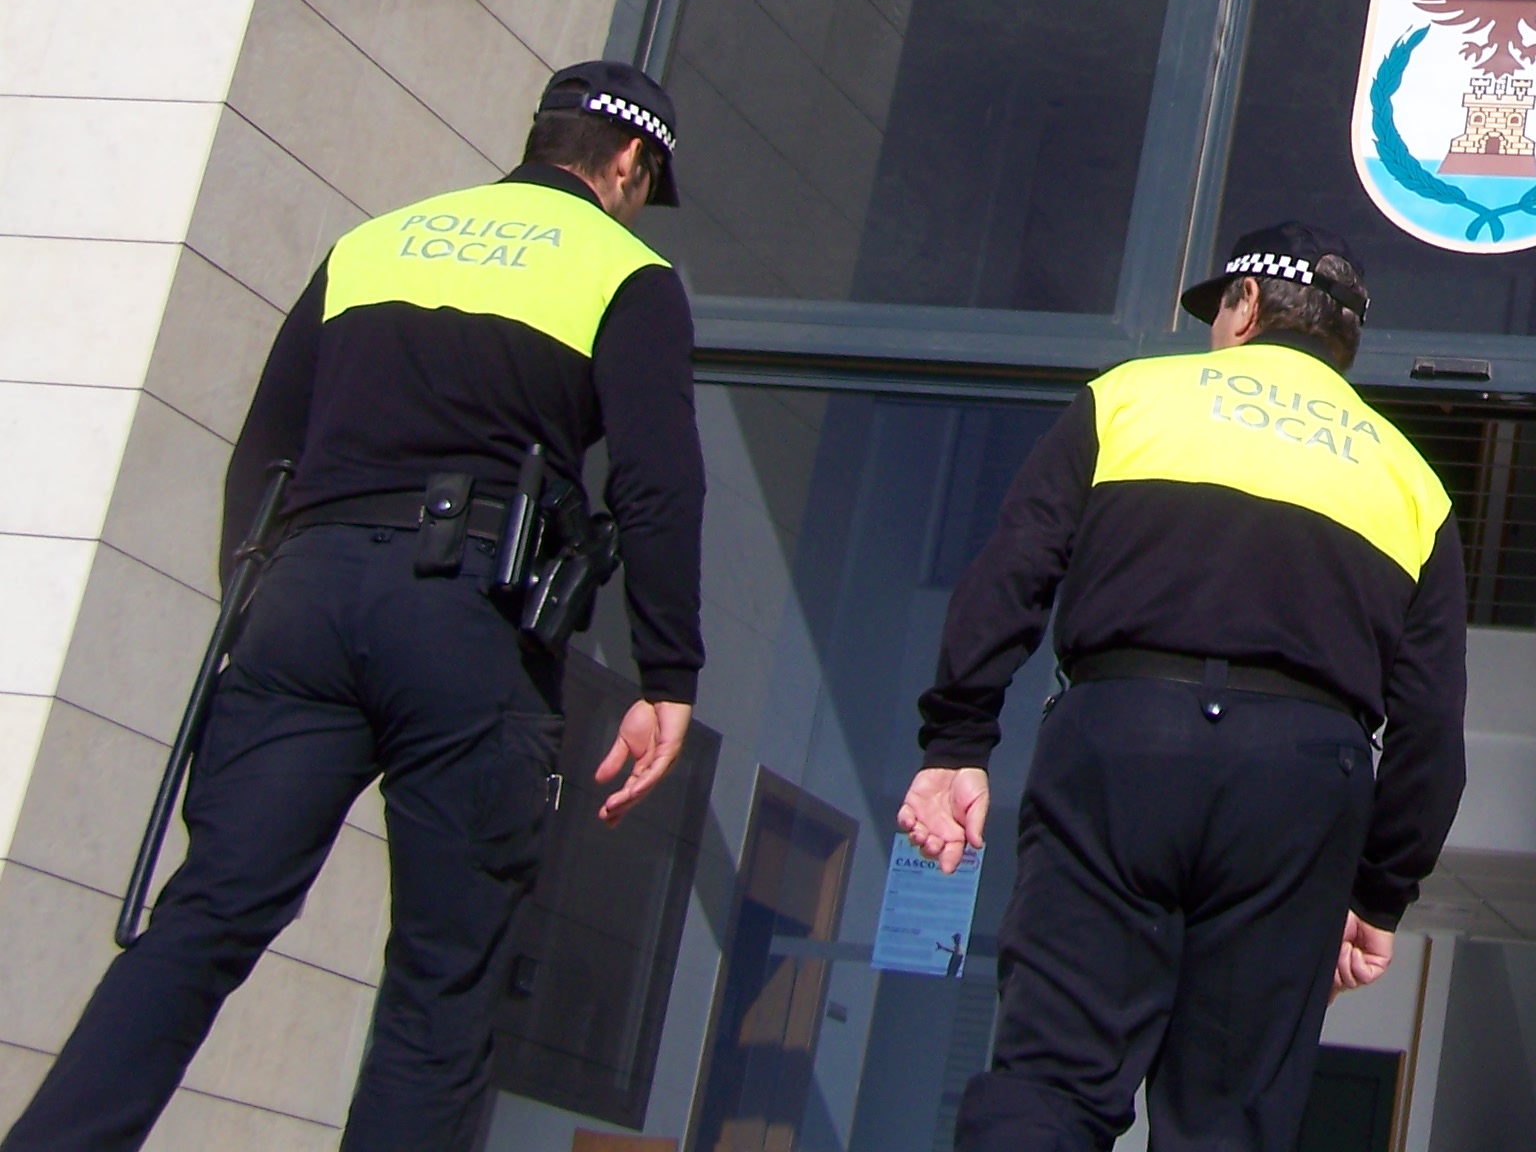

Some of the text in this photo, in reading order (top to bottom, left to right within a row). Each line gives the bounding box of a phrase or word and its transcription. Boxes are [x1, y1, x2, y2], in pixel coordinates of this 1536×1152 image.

[400, 214, 562, 248] POLICIA
[400, 236, 528, 268] LOCAL
[1200, 367, 1381, 444] POLICIA
[1212, 395, 1360, 465] LOCAL
[895, 857, 936, 869] CASCO
